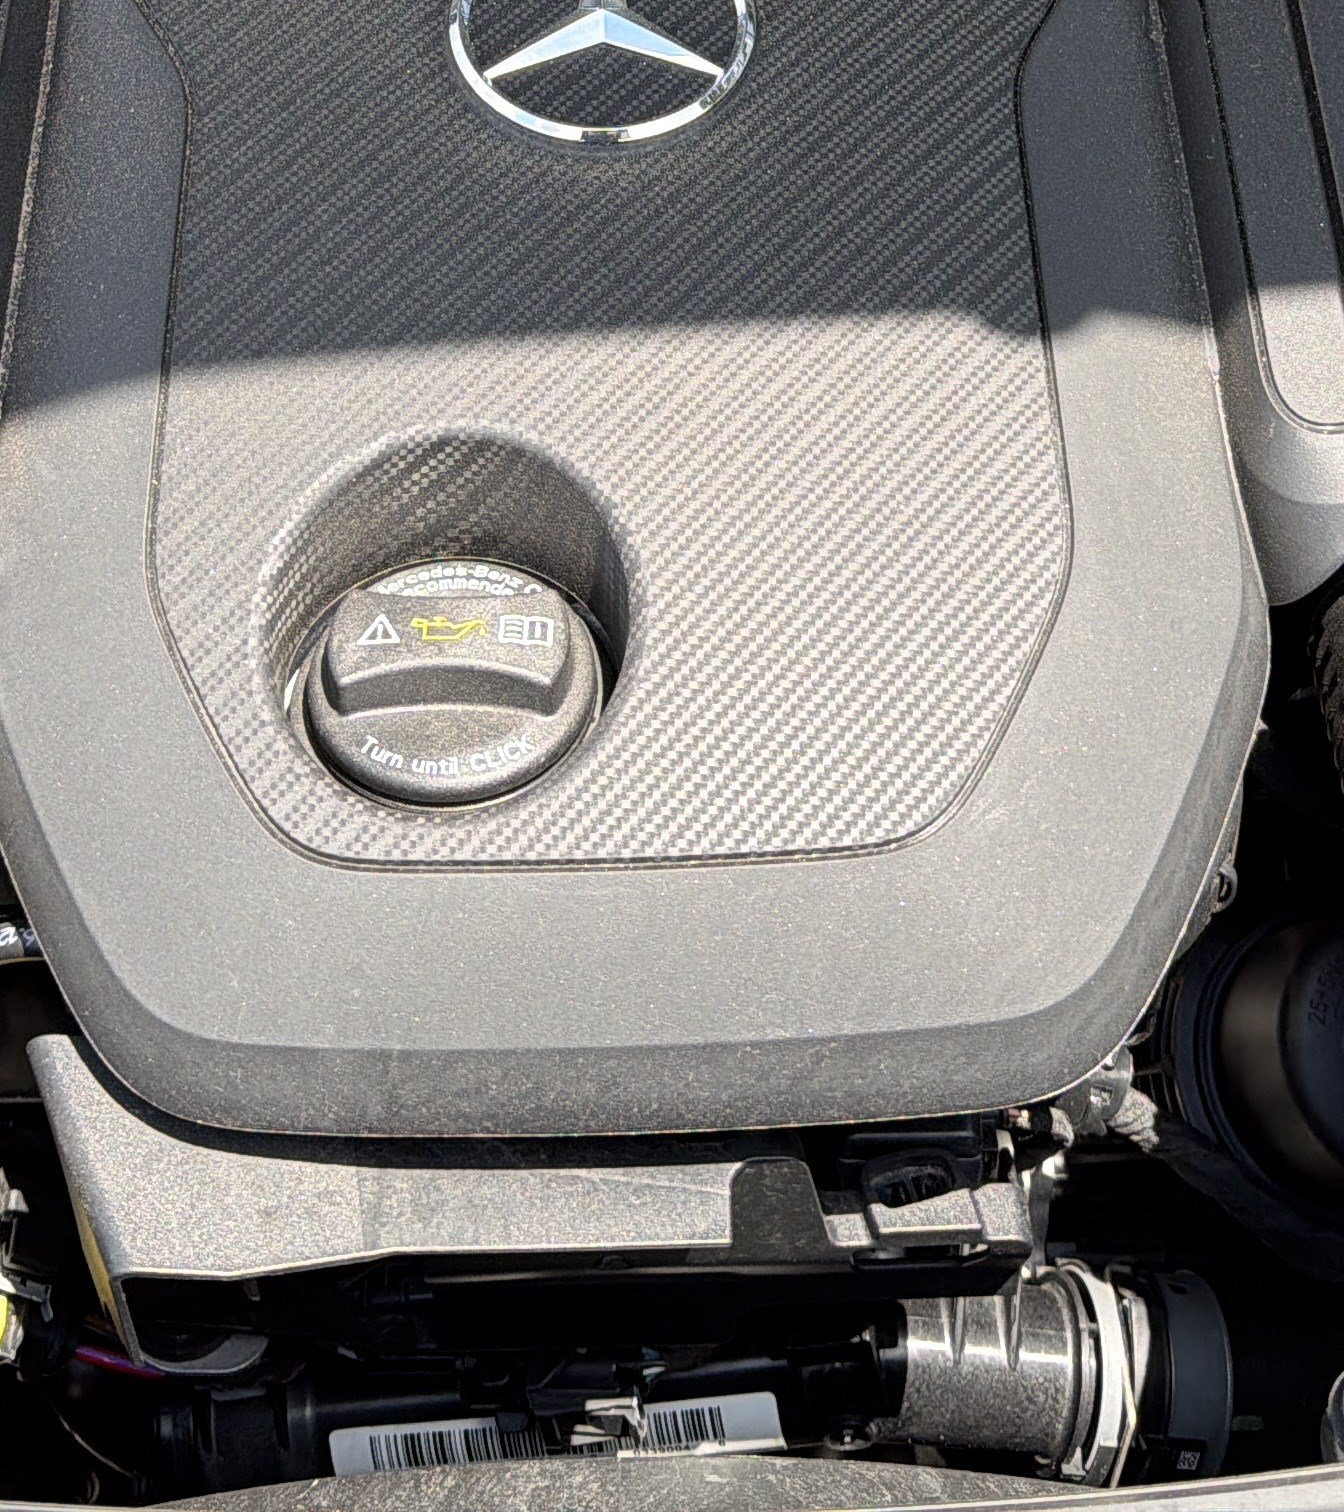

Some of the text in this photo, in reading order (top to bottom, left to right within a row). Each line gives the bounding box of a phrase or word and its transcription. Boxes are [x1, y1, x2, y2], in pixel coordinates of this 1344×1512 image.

[360, 734, 535, 776] Turn until CLICK
